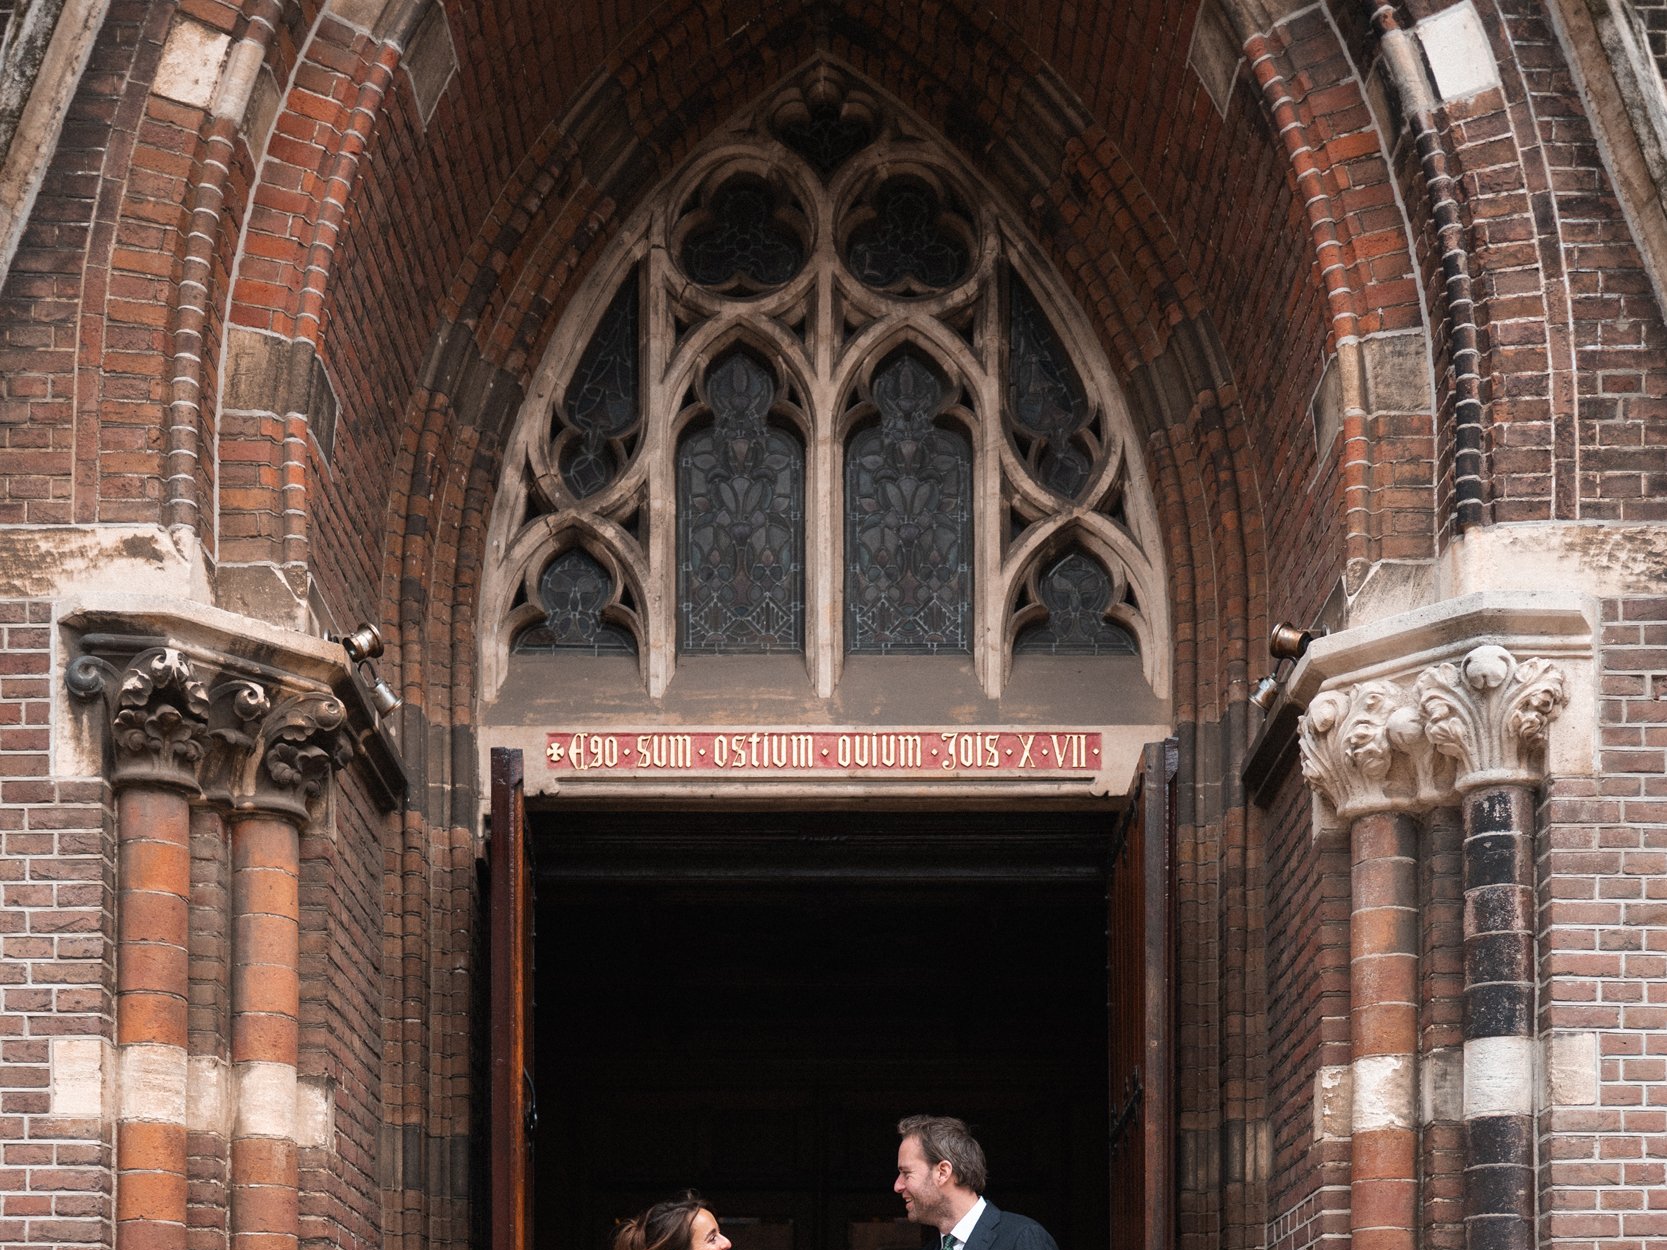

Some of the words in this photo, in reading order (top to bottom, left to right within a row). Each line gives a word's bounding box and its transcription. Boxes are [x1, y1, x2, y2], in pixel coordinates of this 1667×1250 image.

[568, 733, 618, 770] Ego
[637, 734, 691, 768] sum
[713, 732, 813, 768] ostium
[941, 732, 1000, 770] Jois
